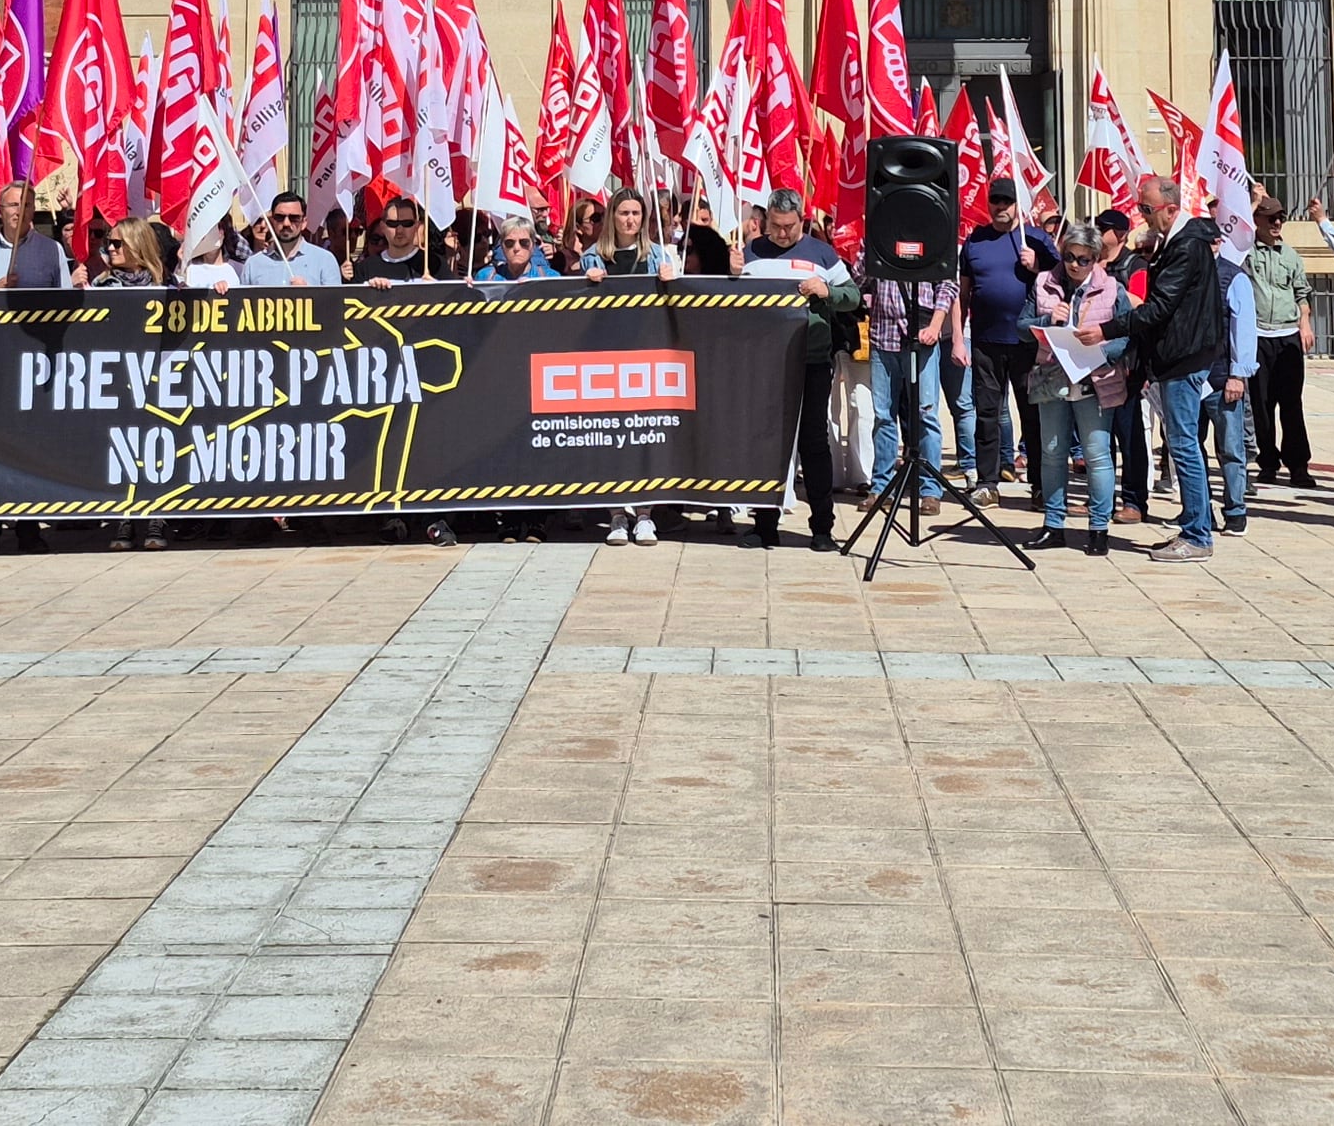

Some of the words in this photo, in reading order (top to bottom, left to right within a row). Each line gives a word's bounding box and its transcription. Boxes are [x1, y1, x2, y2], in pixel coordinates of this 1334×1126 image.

[975, 62, 1031, 73] JUSICIA
[145, 299, 186, 334] 28
[194, 298, 228, 333] DE
[237, 297, 322, 333] ABRIL
[20, 345, 273, 411] PREVENIR
[289, 345, 422, 406] PARA
[544, 363, 686, 399] CCOO
[531, 415, 620, 431] comisiones
[624, 414, 680, 429] obreras
[531, 434, 551, 448] de
[554, 431, 614, 447] Castilla
[617, 435, 627, 450] y
[629, 429, 666, 445] León
[108, 426, 175, 485] NO
[189, 421, 347, 483] MORIR
